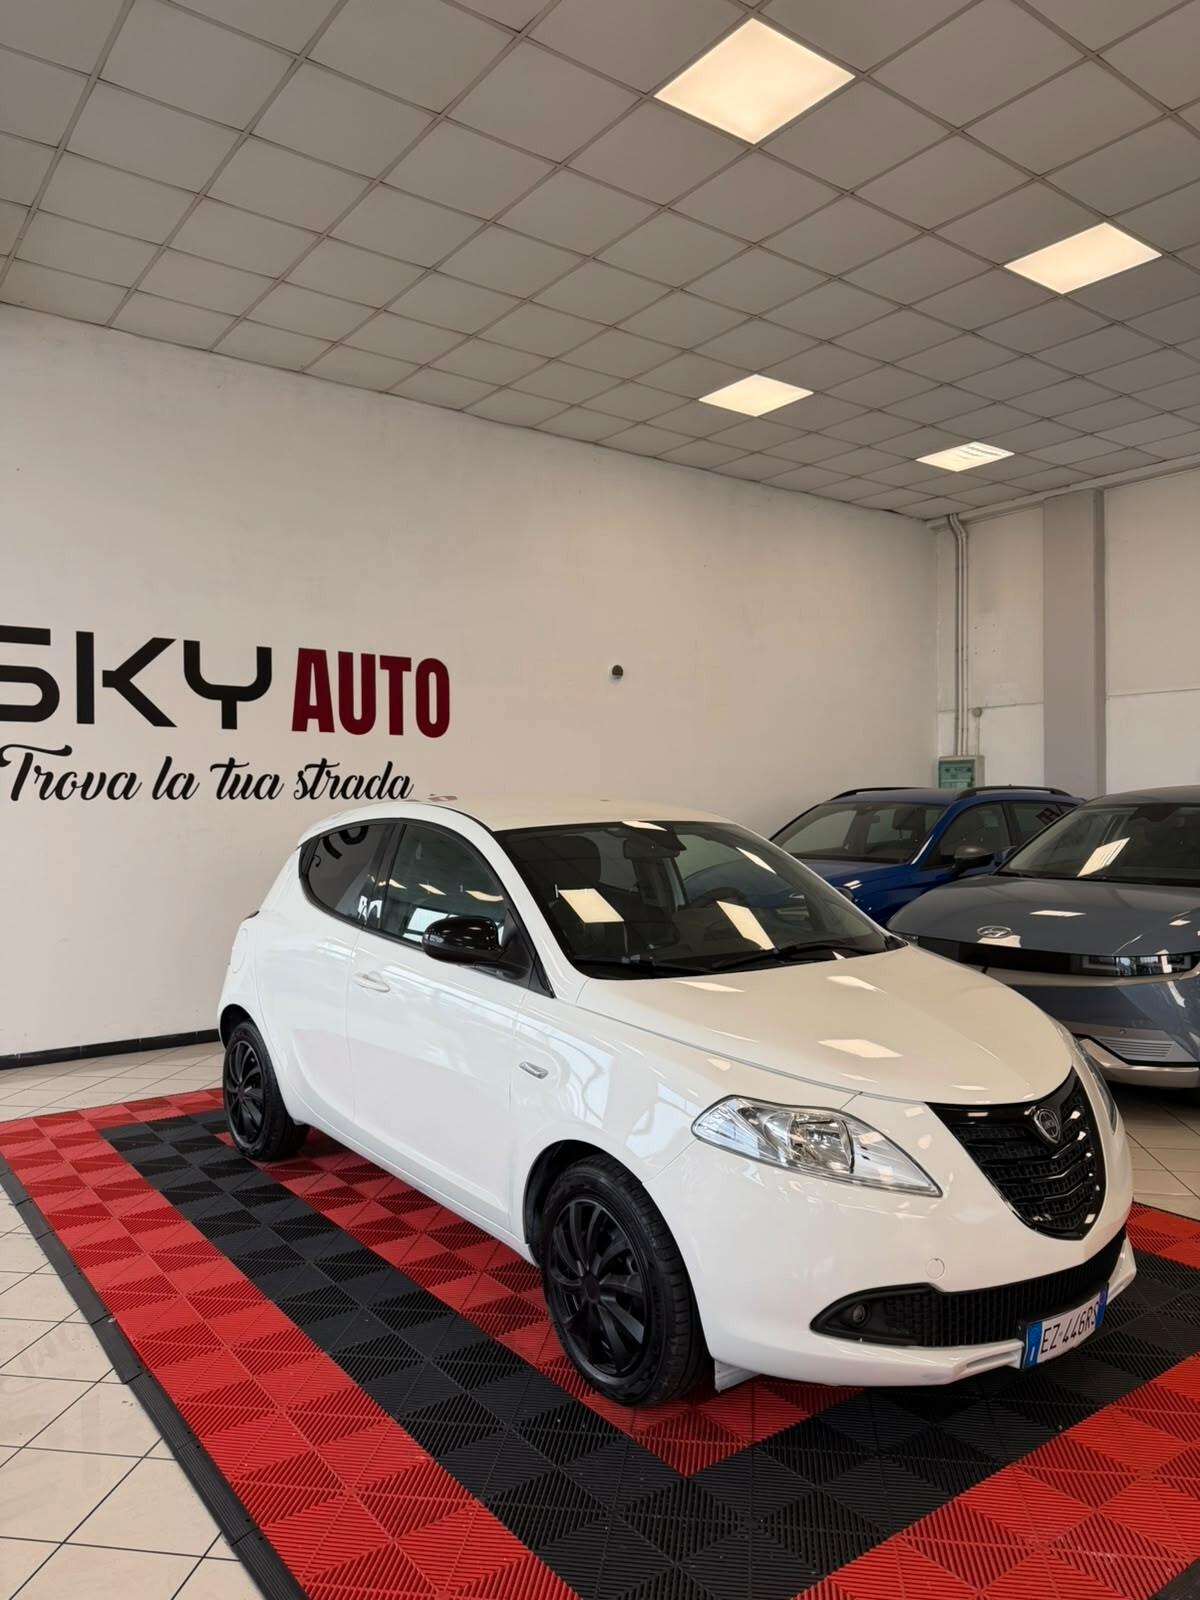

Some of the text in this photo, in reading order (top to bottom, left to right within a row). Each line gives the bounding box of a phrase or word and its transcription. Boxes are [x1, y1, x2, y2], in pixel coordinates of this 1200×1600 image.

[0, 625, 450, 738] SKY AUTO
[0, 744, 415, 801] Trova la tua strada
[1041, 1322, 1061, 1354] EZ
